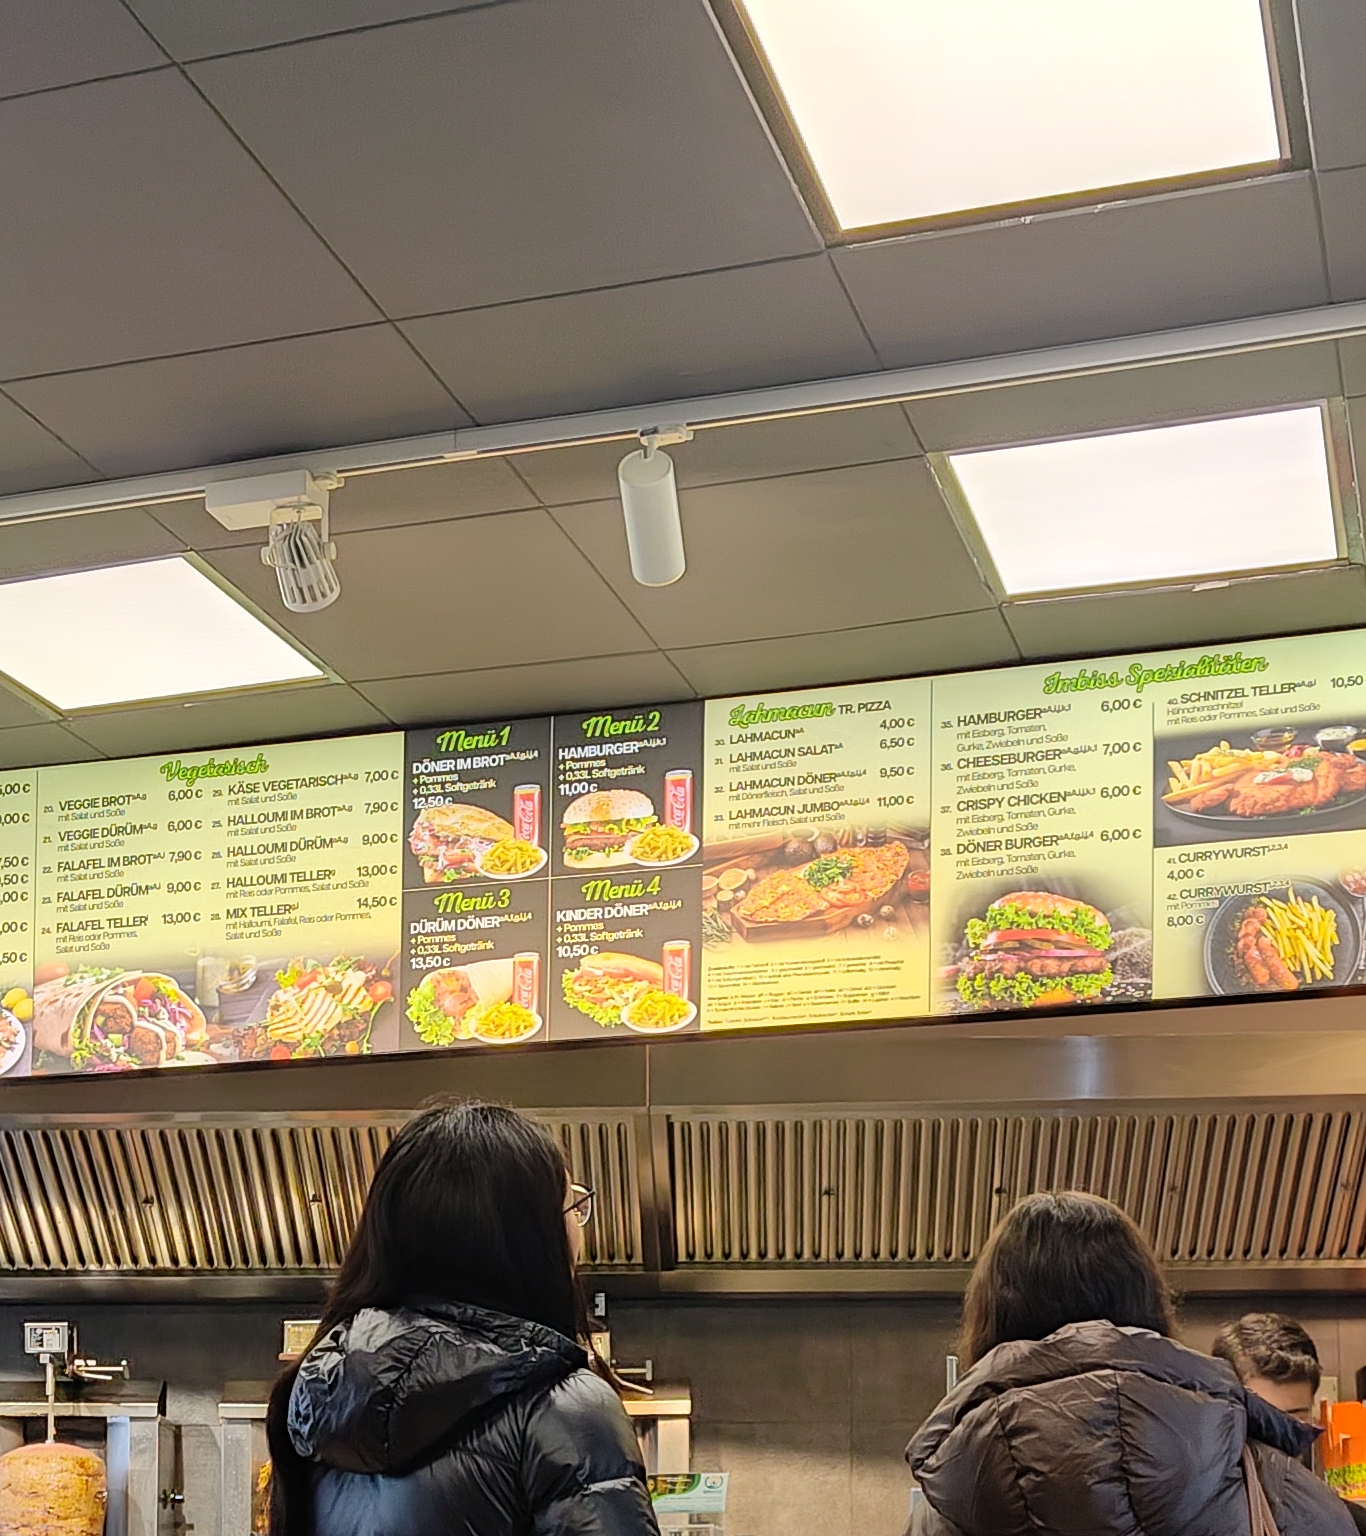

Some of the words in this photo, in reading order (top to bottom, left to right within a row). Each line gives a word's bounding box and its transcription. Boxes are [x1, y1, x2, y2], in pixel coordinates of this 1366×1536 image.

[1043, 668, 1123, 695] Imbiss
[1125, 653, 1268, 692] Spezialitäten
[1181, 687, 1249, 704] SCHNITZEL
[728, 702, 836, 729] Lahmacun
[838, 704, 856, 715] TR.
[858, 700, 891, 713] PIZZA
[582, 715, 646, 737] Menü
[647, 711, 660, 731] 2
[437, 730, 499, 751] Menü
[500, 726, 513, 745] 1
[730, 748, 795, 763] LAHMACUN
[160, 753, 269, 787] Vegetarisch
[413, 759, 455, 774] DÖNER
[457, 758, 471, 770] IM
[59, 797, 100, 811] VEGGIE
[957, 797, 1005, 812] CRISPY
[228, 811, 288, 826] HALLOUMI
[291, 809, 303, 820] IM
[581, 880, 645, 901] Menü
[646, 876, 661, 895] 4
[434, 892, 496, 913] Menü
[498, 889, 510, 907] 3
[226, 907, 247, 919] MIX
[557, 908, 603, 922] KINDER
[57, 919, 105, 933] FALAFEL
[411, 918, 455, 934] DÜRÜM
